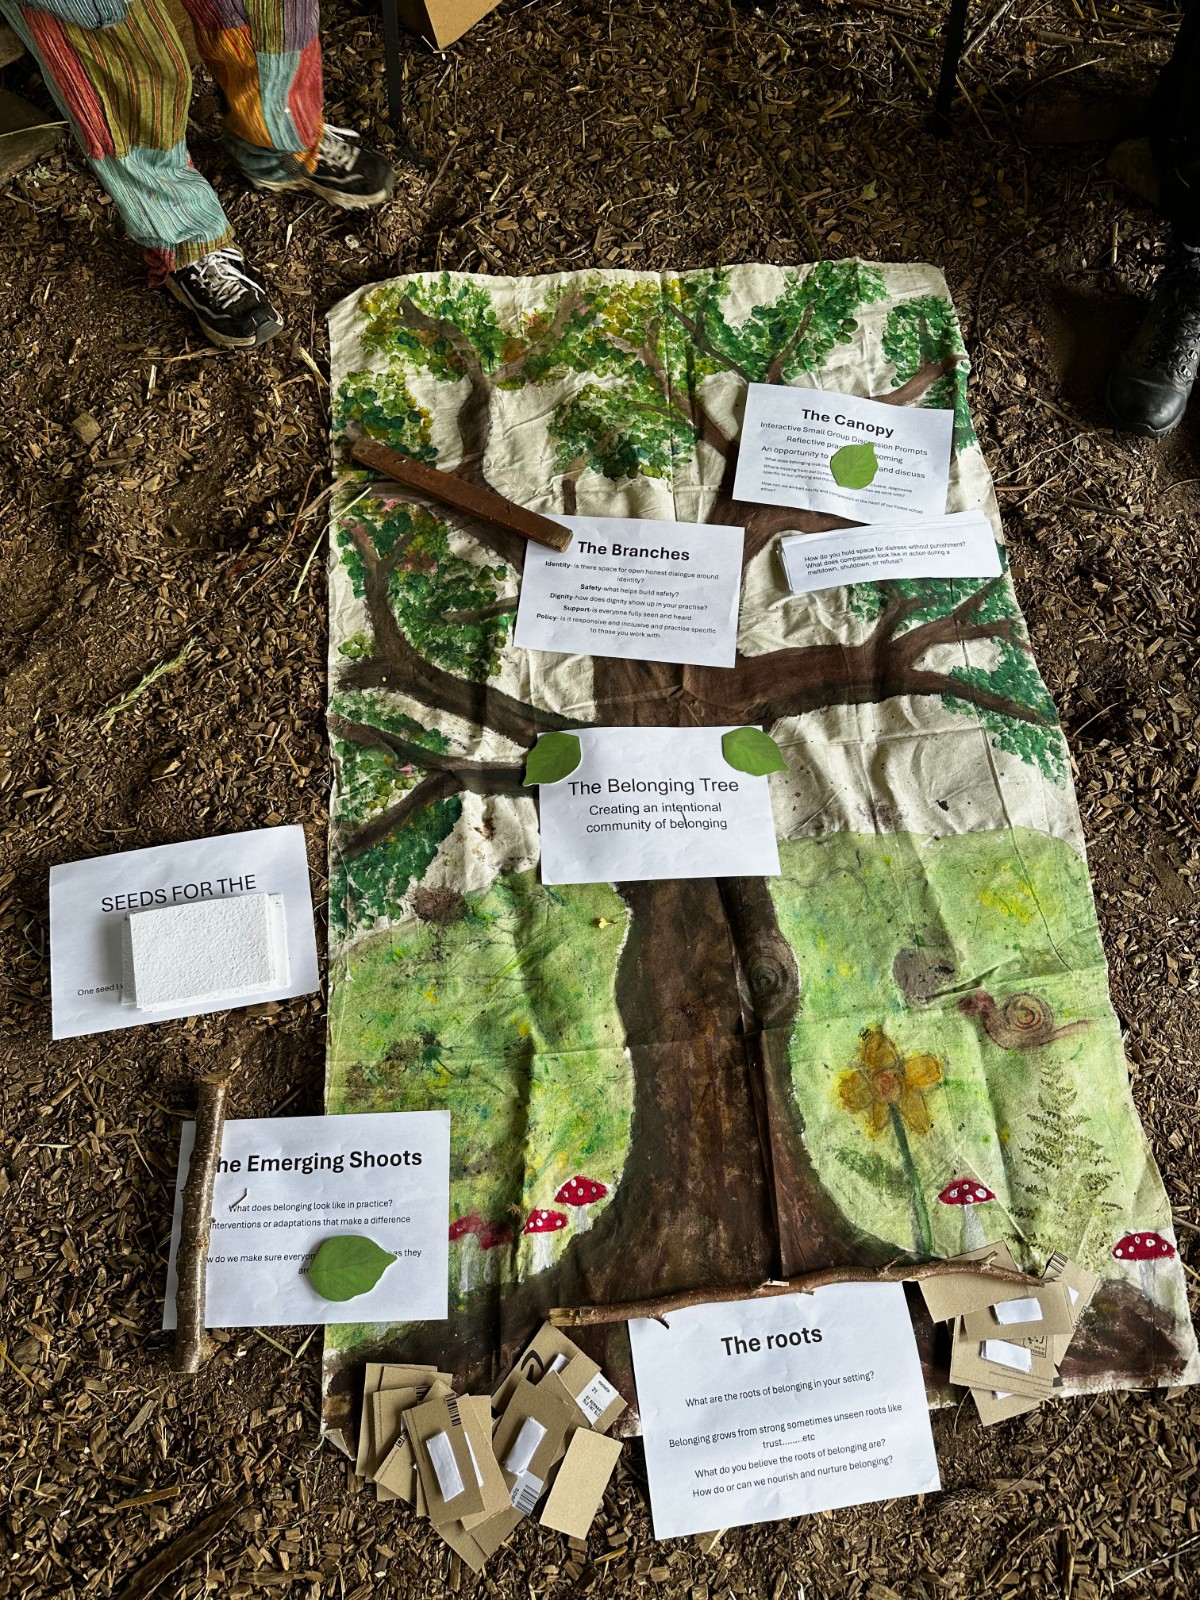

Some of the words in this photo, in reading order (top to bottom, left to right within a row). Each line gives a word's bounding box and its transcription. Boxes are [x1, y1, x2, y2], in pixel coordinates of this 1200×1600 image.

[802, 409, 830, 422] The
[835, 414, 894, 438] Canopy
[760, 422, 801, 432] Interactive
[803, 427, 825, 435] Small
[827, 430, 850, 441] Group
[895, 445, 928, 456] Prompts
[786, 436, 825, 446] Reflective
[773, 447, 820, 459] opportunity
[895, 468, 926, 479] discuss
[578, 541, 607, 555] The
[612, 544, 690, 560] Branches
[840, 555, 876, 563] compassion
[668, 570, 695, 579] dialogue
[807, 566, 839, 575] meltdown,
[840, 562, 871, 570] shutdown,
[616, 576, 645, 584] identity?
[606, 597, 627, 606] dignity
[598, 608, 627, 616] everyone
[628, 610, 642, 618] fully
[573, 617, 607, 625] responsive
[621, 620, 650, 629] inclusive
[568, 781, 602, 796] The
[607, 778, 695, 796] Belonging
[699, 778, 739, 792] Tree
[589, 803, 640, 816] Creating
[643, 804, 658, 813] an
[661, 802, 722, 812] intentional
[586, 819, 651, 833] community
[655, 818, 667, 829] of
[670, 818, 728, 830] belonging
[101, 888, 167, 913] SEEDS
[172, 881, 214, 902] FOR
[217, 874, 257, 894] THE
[95, 983, 115, 993] seed
[247, 1153, 345, 1175] Emerging
[349, 1150, 422, 1168] Shoots
[228, 1204, 250, 1213] What
[251, 1203, 272, 1211] does
[273, 1202, 312, 1212] belonging
[313, 1201, 331, 1210] look
[332, 1201, 346, 1209] like
[356, 1199, 393, 1209] practice?
[209, 1220, 261, 1230] Interventions
[273, 1219, 321, 1228] adaptations
[323, 1218, 339, 1226] that
[340, 1217, 362, 1225] make
[370, 1216, 411, 1224] difference
[215, 1255, 226, 1263] do
[240, 1254, 263, 1262] make
[404, 1249, 422, 1257] they
[720, 1335, 762, 1356] The
[766, 1327, 823, 1350] roots
[685, 1397, 708, 1408] What
[709, 1394, 723, 1404] are
[724, 1391, 738, 1401] the
[739, 1390, 761, 1400] roots
[762, 1386, 771, 1395] of
[772, 1381, 813, 1394] belonging
[813, 1380, 822, 1388] in
[823, 1377, 841, 1389] your
[842, 1370, 875, 1383] setting?
[669, 1435, 711, 1448] Belonging
[712, 1431, 737, 1443] grows
[737, 1427, 758, 1438] from
[759, 1423, 786, 1434] strong
[786, 1415, 833, 1430] sometimes
[834, 1410, 865, 1422] unseen
[865, 1406, 887, 1416] roots
[887, 1403, 903, 1413] like
[694, 1468, 718, 1479] What
[719, 1466, 730, 1475] do
[731, 1463, 747, 1474] you
[748, 1458, 778, 1469] believe
[779, 1455, 793, 1464] the
[794, 1451, 816, 1461] roots
[817, 1449, 826, 1458] of
[827, 1444, 867, 1456] belonging
[868, 1438, 886, 1448] are?
[692, 1488, 712, 1498] How
[713, 1485, 724, 1494] do
[736, 1481, 752, 1490] can
[754, 1479, 766, 1487] we
[767, 1472, 799, 1484] nourish
[800, 1469, 816, 1479] and
[817, 1466, 848, 1475] nurture
[849, 1455, 894, 1470] belonging?
